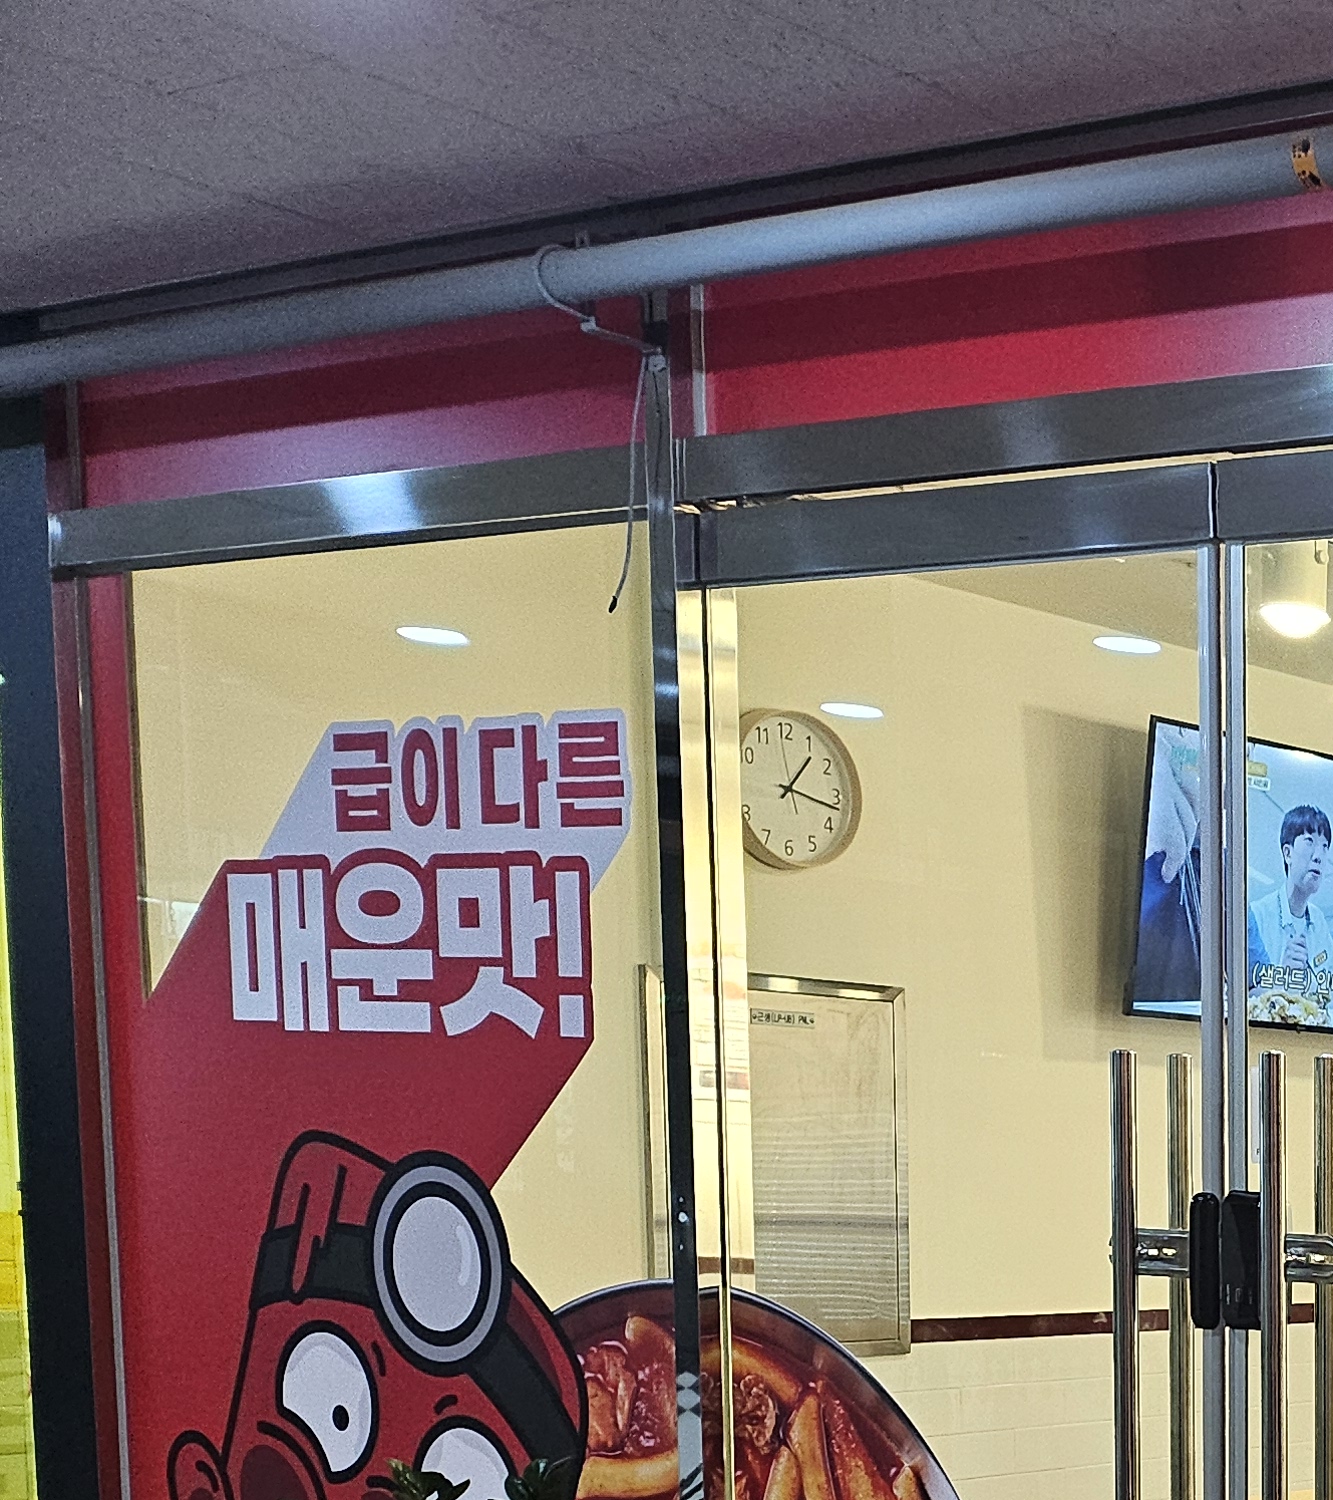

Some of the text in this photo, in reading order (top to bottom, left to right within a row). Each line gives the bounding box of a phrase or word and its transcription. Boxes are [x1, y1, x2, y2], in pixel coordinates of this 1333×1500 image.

[755, 726, 769, 745] 11
[777, 722, 793, 741] 12
[805, 735, 812, 752] 1
[822, 758, 831, 776] 2
[831, 788, 841, 806] 3
[823, 816, 834, 834] 4
[761, 828, 771, 846] 7
[807, 835, 817, 852] 5
[784, 839, 794, 857] 6
[1252, 962, 1312, 993] (샐러드)
